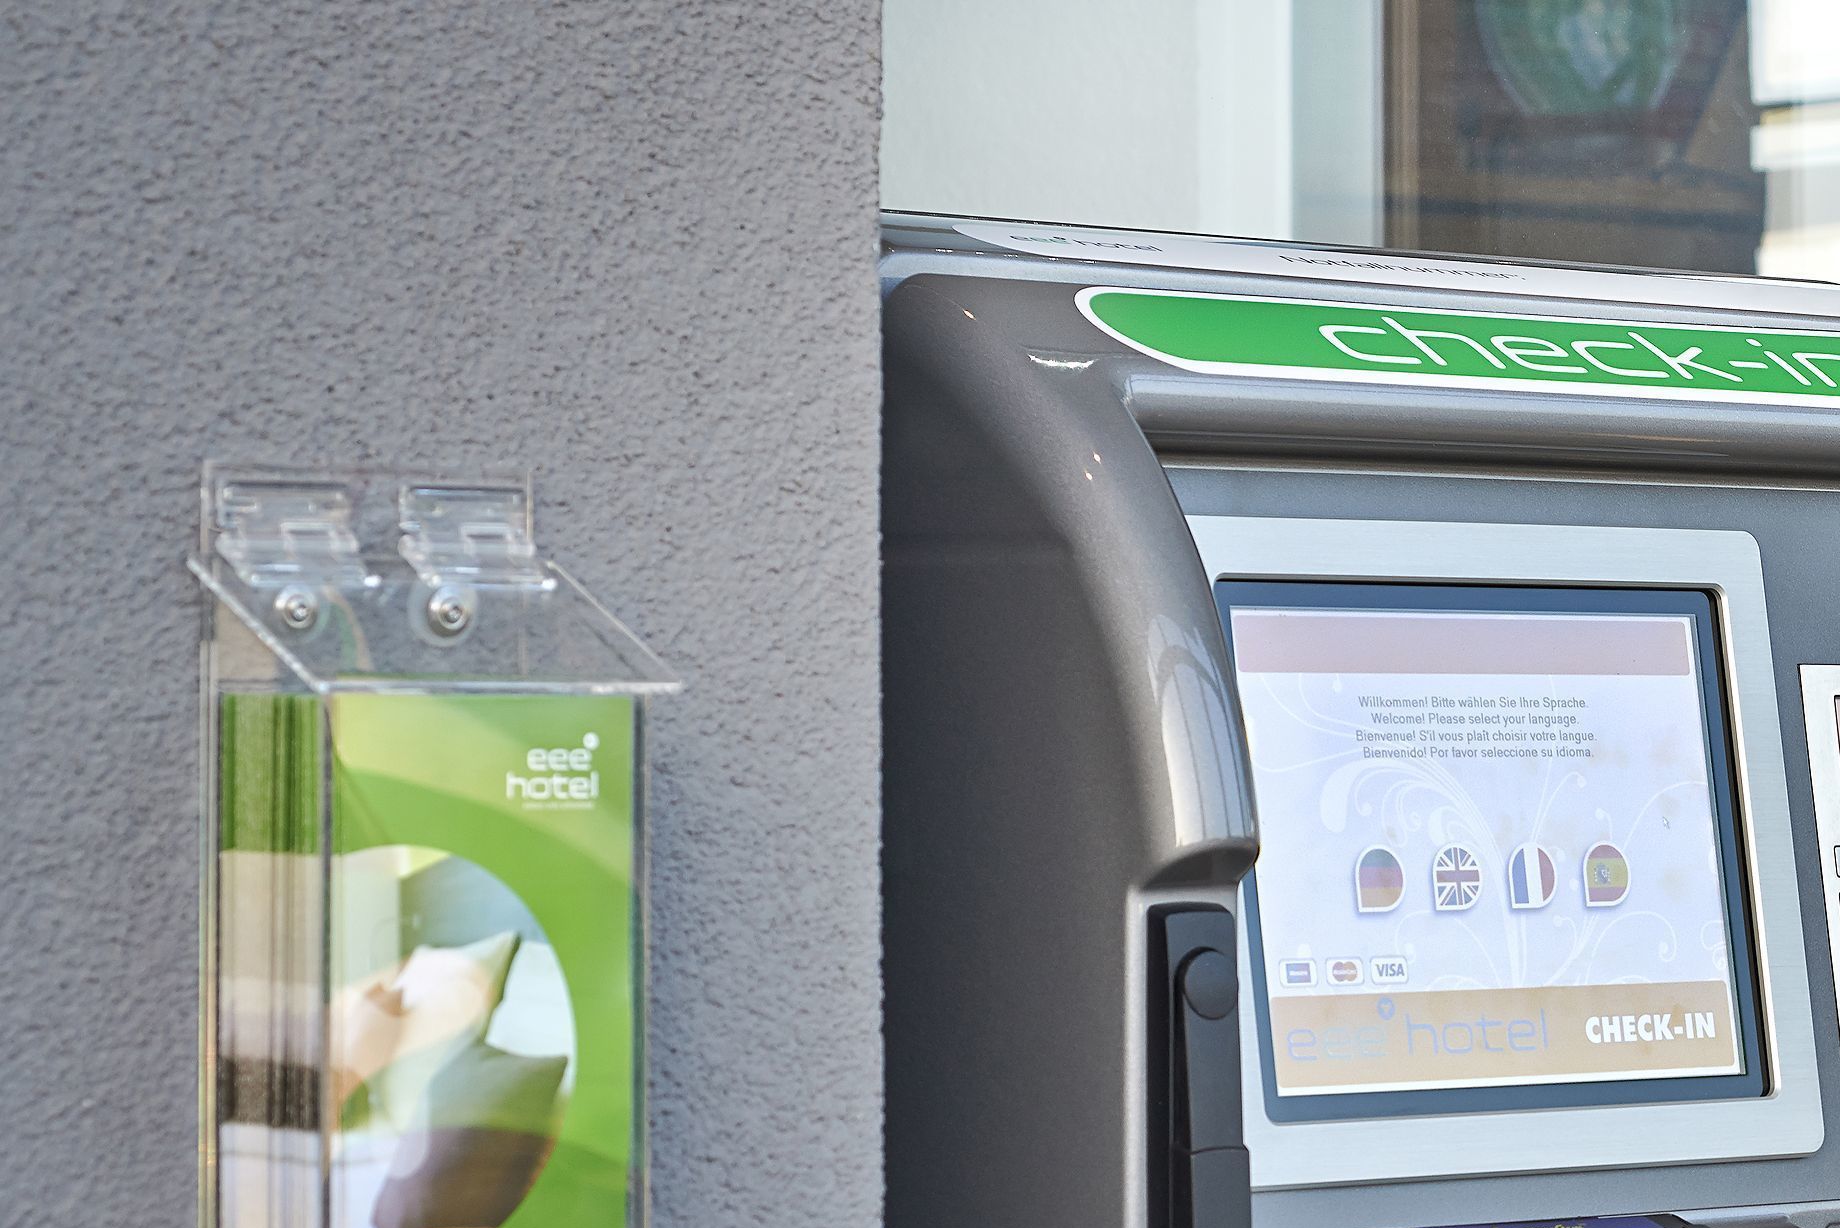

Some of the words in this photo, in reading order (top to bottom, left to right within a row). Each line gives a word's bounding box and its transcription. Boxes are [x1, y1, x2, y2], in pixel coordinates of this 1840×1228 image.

[1358, 696, 1428, 708] Willkommen!
[1431, 696, 1456, 708] Bitte
[1458, 696, 1496, 708] wählen
[1499, 697, 1517, 708] Sie
[1520, 697, 1540, 708] Ihre
[1542, 697, 1589, 711] Sprache.
[1371, 713, 1425, 724] Welcome!
[1428, 713, 1465, 724] Please
[1468, 713, 1500, 724] select
[1502, 715, 1525, 727] your
[1528, 713, 1579, 727] language.
[1356, 730, 1416, 741] Bienvenue!
[1420, 730, 1436, 741] S'il
[1438, 732, 1461, 741] vous
[1492, 730, 1527, 741] choisir
[1530, 731, 1556, 741] votre
[1559, 730, 1598, 744] langue.
[1363, 747, 1427, 758] Bienvenido!
[1430, 747, 1449, 758] Por
[1452, 747, 1478, 758] favor
[1481, 747, 1538, 757] seleccione
[1541, 749, 1553, 757] su
[1556, 747, 1594, 758] idioma.
[506, 770, 599, 800] hotel
[1376, 963, 1405, 977] VISA
[1287, 1026, 1387, 1061] eee
[1406, 1009, 1549, 1056] hotel
[1585, 1011, 1716, 1045] CHECK-IN
